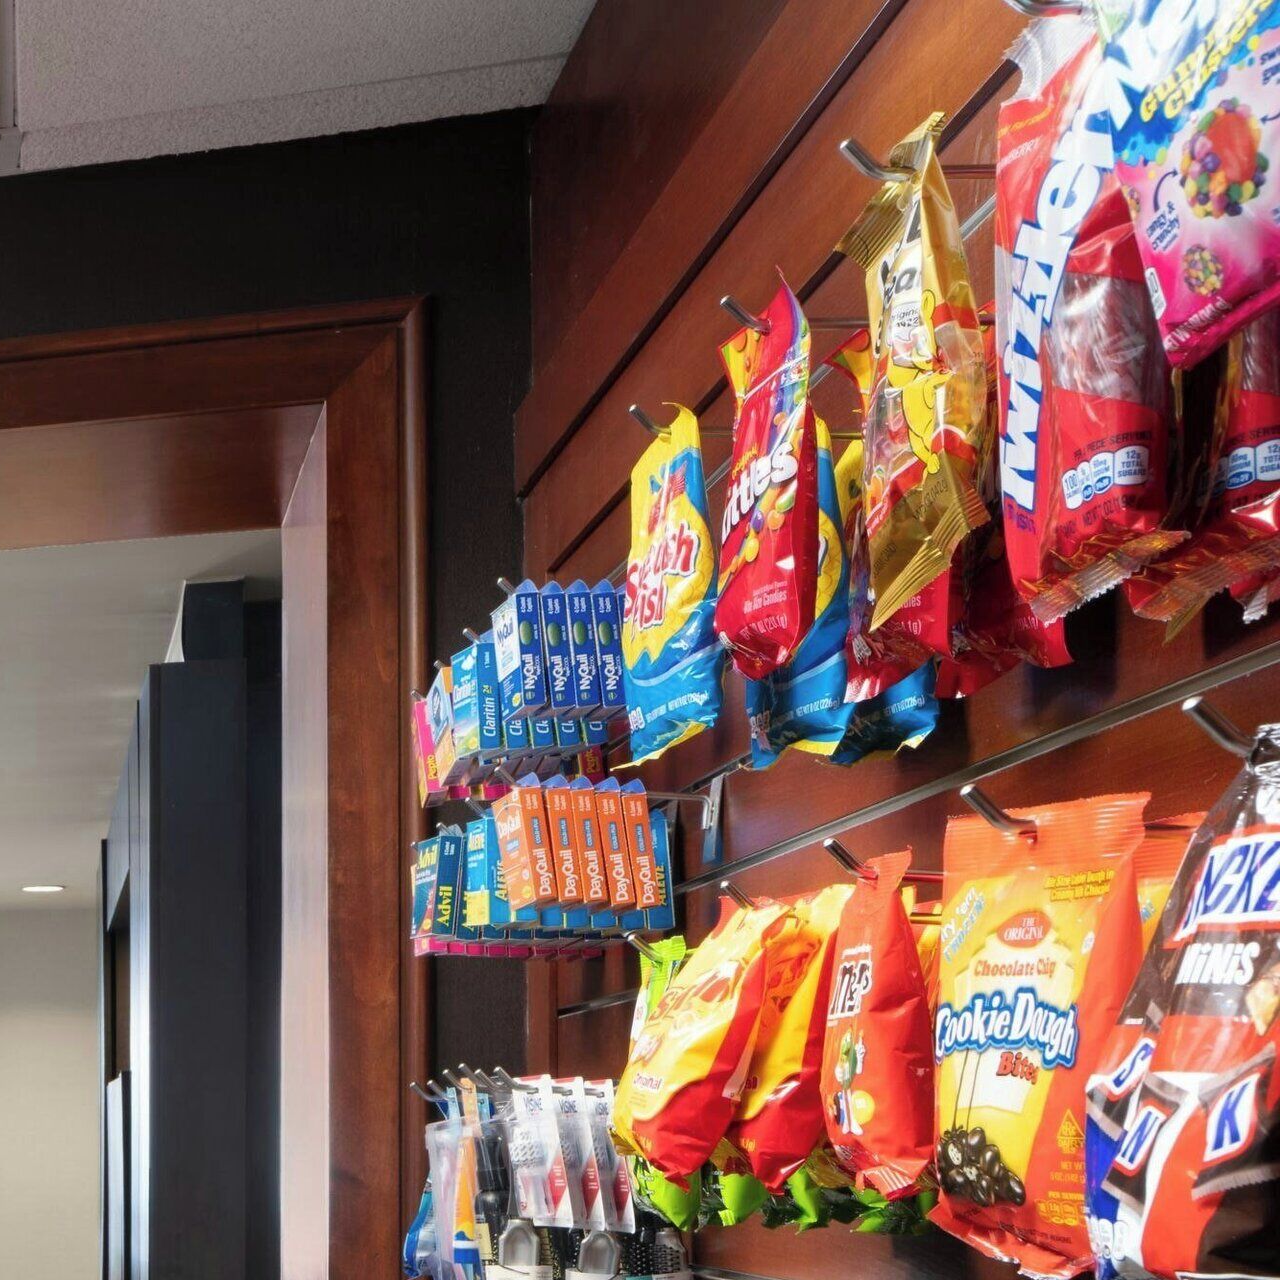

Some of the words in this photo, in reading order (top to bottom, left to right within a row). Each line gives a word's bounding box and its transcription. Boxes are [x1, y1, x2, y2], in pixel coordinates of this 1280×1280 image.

[523, 653, 538, 690] NyQuil
[551, 655, 568, 692] NyQuil
[576, 653, 593, 690] NyQuil
[602, 653, 618, 690] NyQuil
[483, 696, 496, 737] Claritin
[533, 847, 553, 896] DayQuil
[558, 849, 577, 898] DayQuil
[584, 850, 602, 899] DayQuil
[609, 853, 629, 903] DayQuil
[637, 855, 655, 905] DayQuil
[437, 885, 453, 927] Advil
[973, 959, 1035, 978] Chocolate
[1037, 956, 1056, 978] Chip
[936, 997, 1011, 1051] Cookie
[1010, 992, 1076, 1060] Dough
[996, 1051, 1039, 1085] Bites
